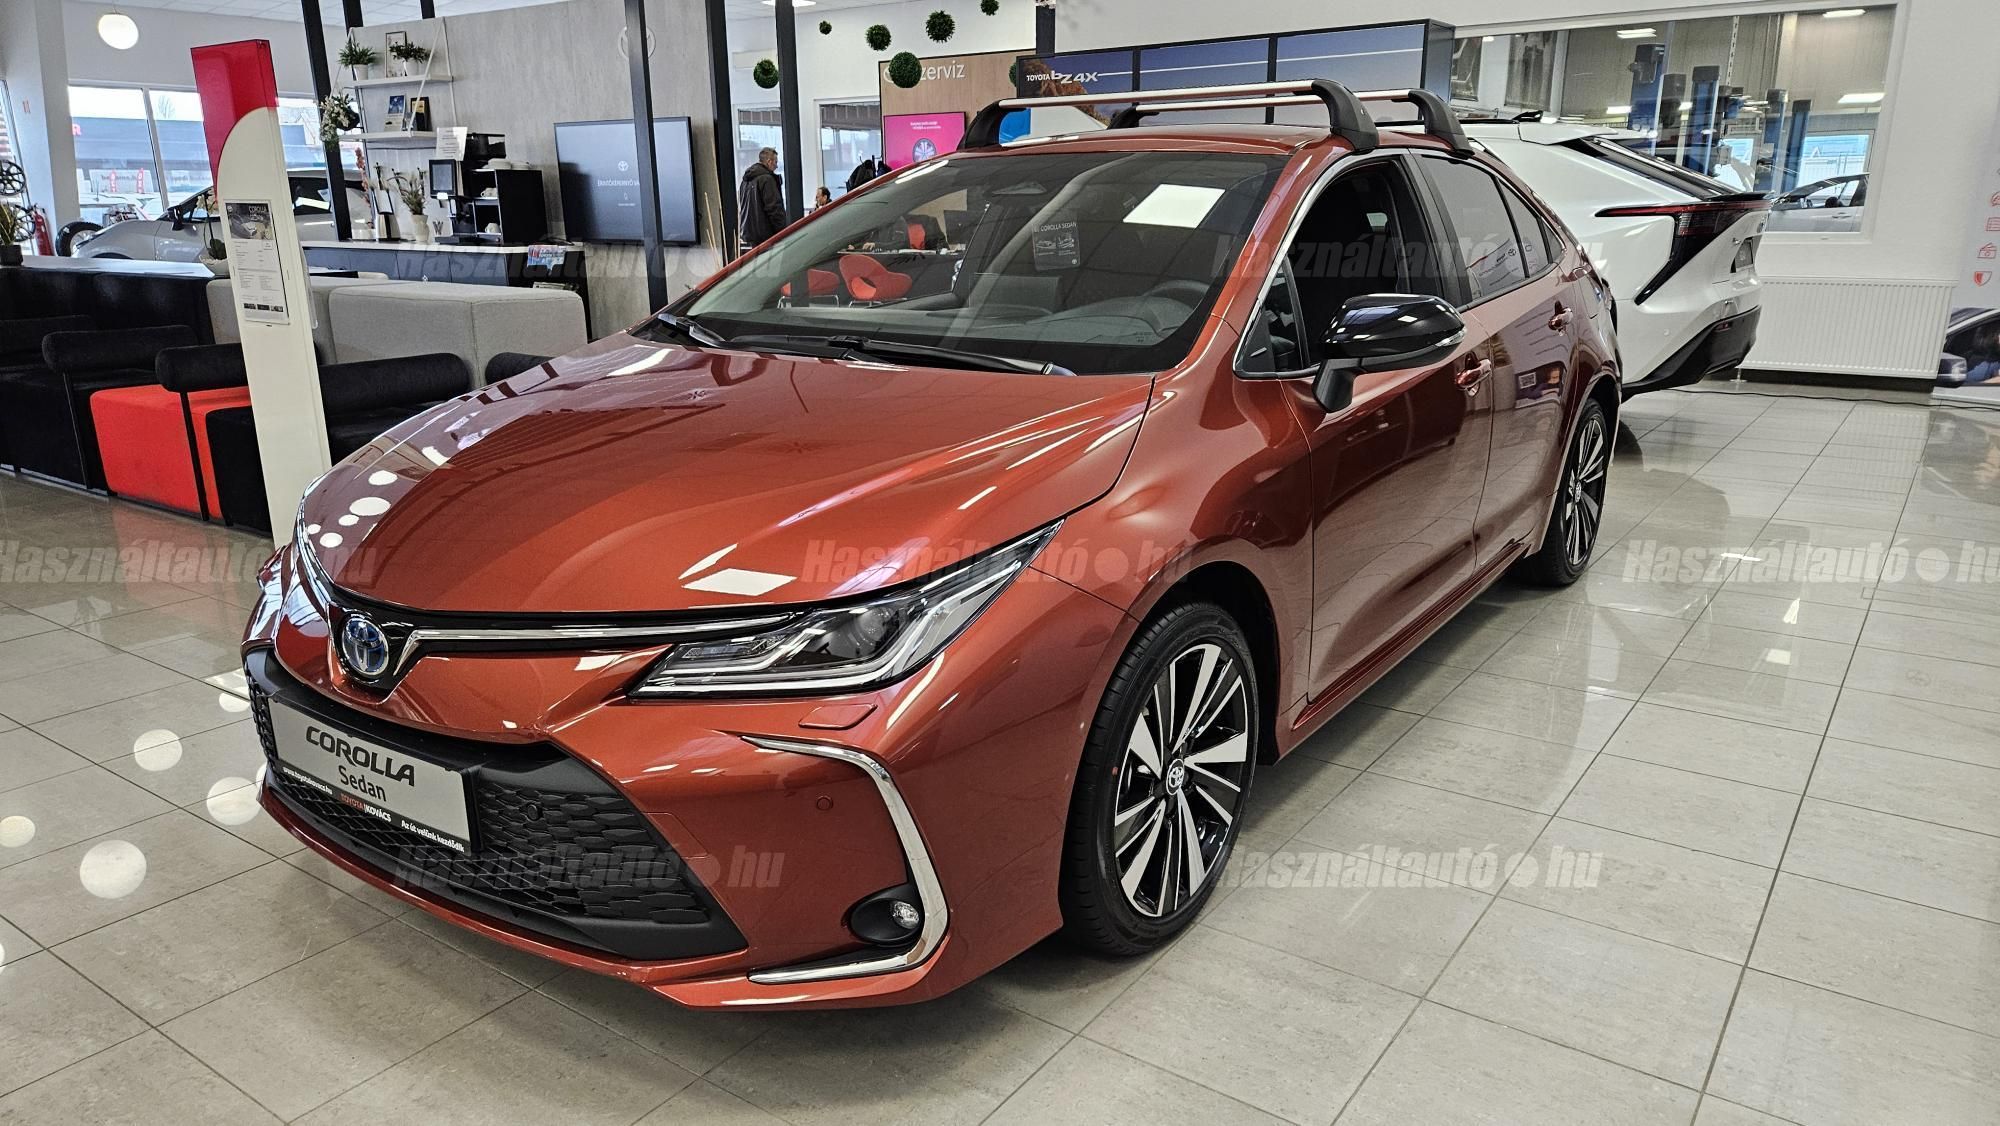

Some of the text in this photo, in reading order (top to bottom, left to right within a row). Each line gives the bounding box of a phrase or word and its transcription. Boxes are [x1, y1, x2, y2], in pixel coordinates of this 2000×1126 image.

[919, 60, 966, 81] zerviz
[1026, 73, 1051, 82] TOYOTA
[306, 725, 415, 787] COROLLA
[338, 765, 387, 802] Sedan
